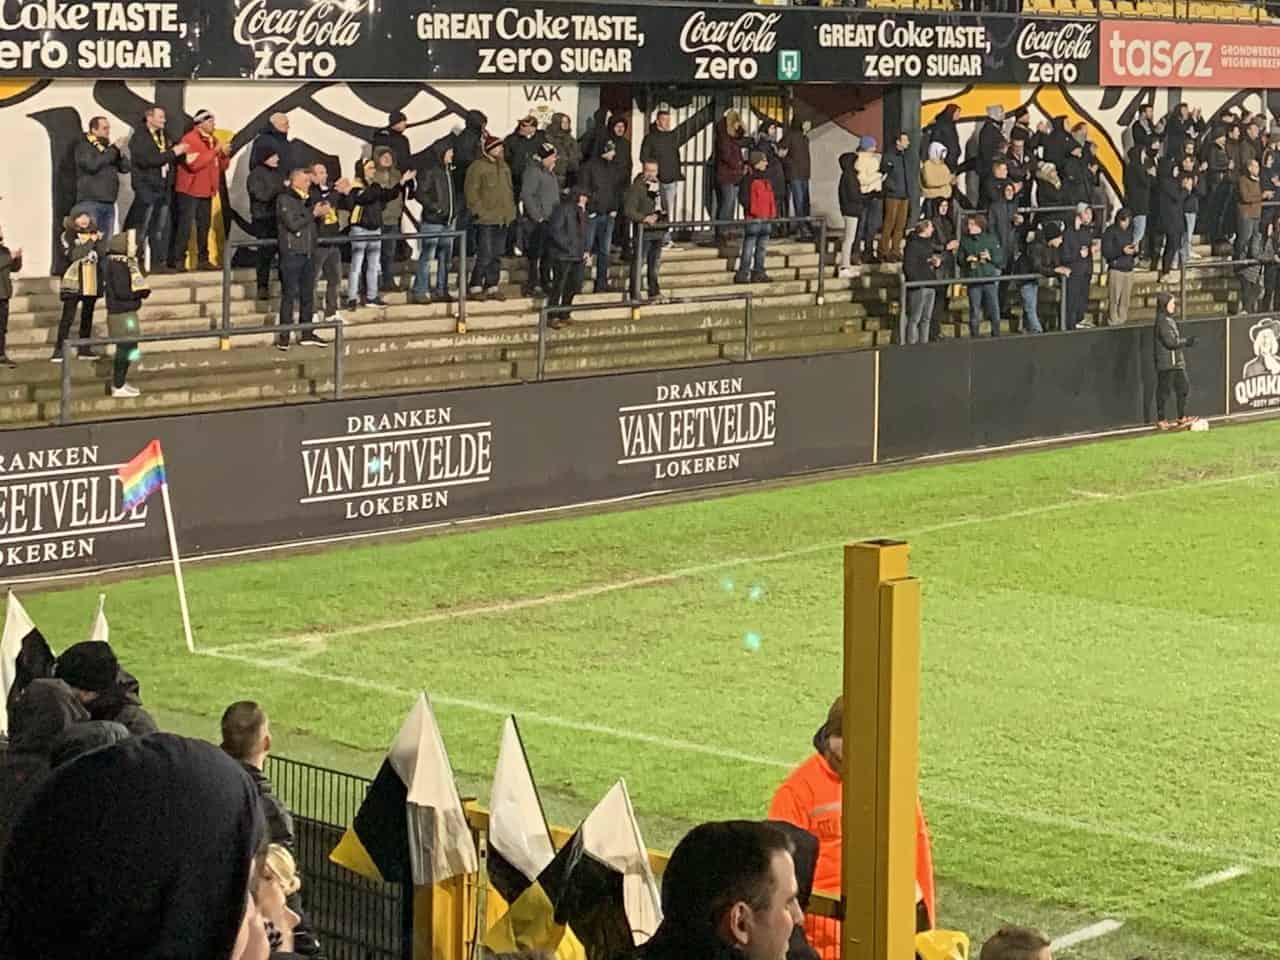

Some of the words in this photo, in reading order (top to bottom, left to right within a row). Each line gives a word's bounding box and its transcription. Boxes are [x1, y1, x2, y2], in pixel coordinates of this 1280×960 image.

[91, 1, 188, 38] TASTE,
[417, 13, 493, 40] GREAT
[495, 7, 571, 41] Coke
[572, 15, 645, 47] TASTE,
[679, 9, 782, 56] Coca-Cola
[818, 22, 877, 48] GREAT
[878, 18, 935, 49] Coke
[935, 26, 992, 54] TASTE,
[1016, 22, 1096, 60] Coca-Cola
[0, 45, 69, 70] ero
[79, 39, 172, 70] SUGAR
[254, 48, 337, 77] zero
[478, 48, 553, 74] zero
[560, 47, 632, 73] SUGAR
[694, 56, 759, 81] zero
[864, 54, 922, 77] zero
[926, 54, 983, 77] SUGAR
[1027, 62, 1078, 83] zero
[523, 85, 562, 103] VAK
[656, 377, 743, 401] DRANKEN
[347, 407, 452, 433] DRANKEN
[618, 411, 663, 457] VAN
[669, 399, 776, 452] EETVELDE
[302, 444, 354, 495] VAN
[361, 430, 492, 489] EETVELDE
[655, 453, 741, 479] LOKEREN
[346, 490, 449, 520] LOKEREN
[0, 538, 95, 566] KEREN
